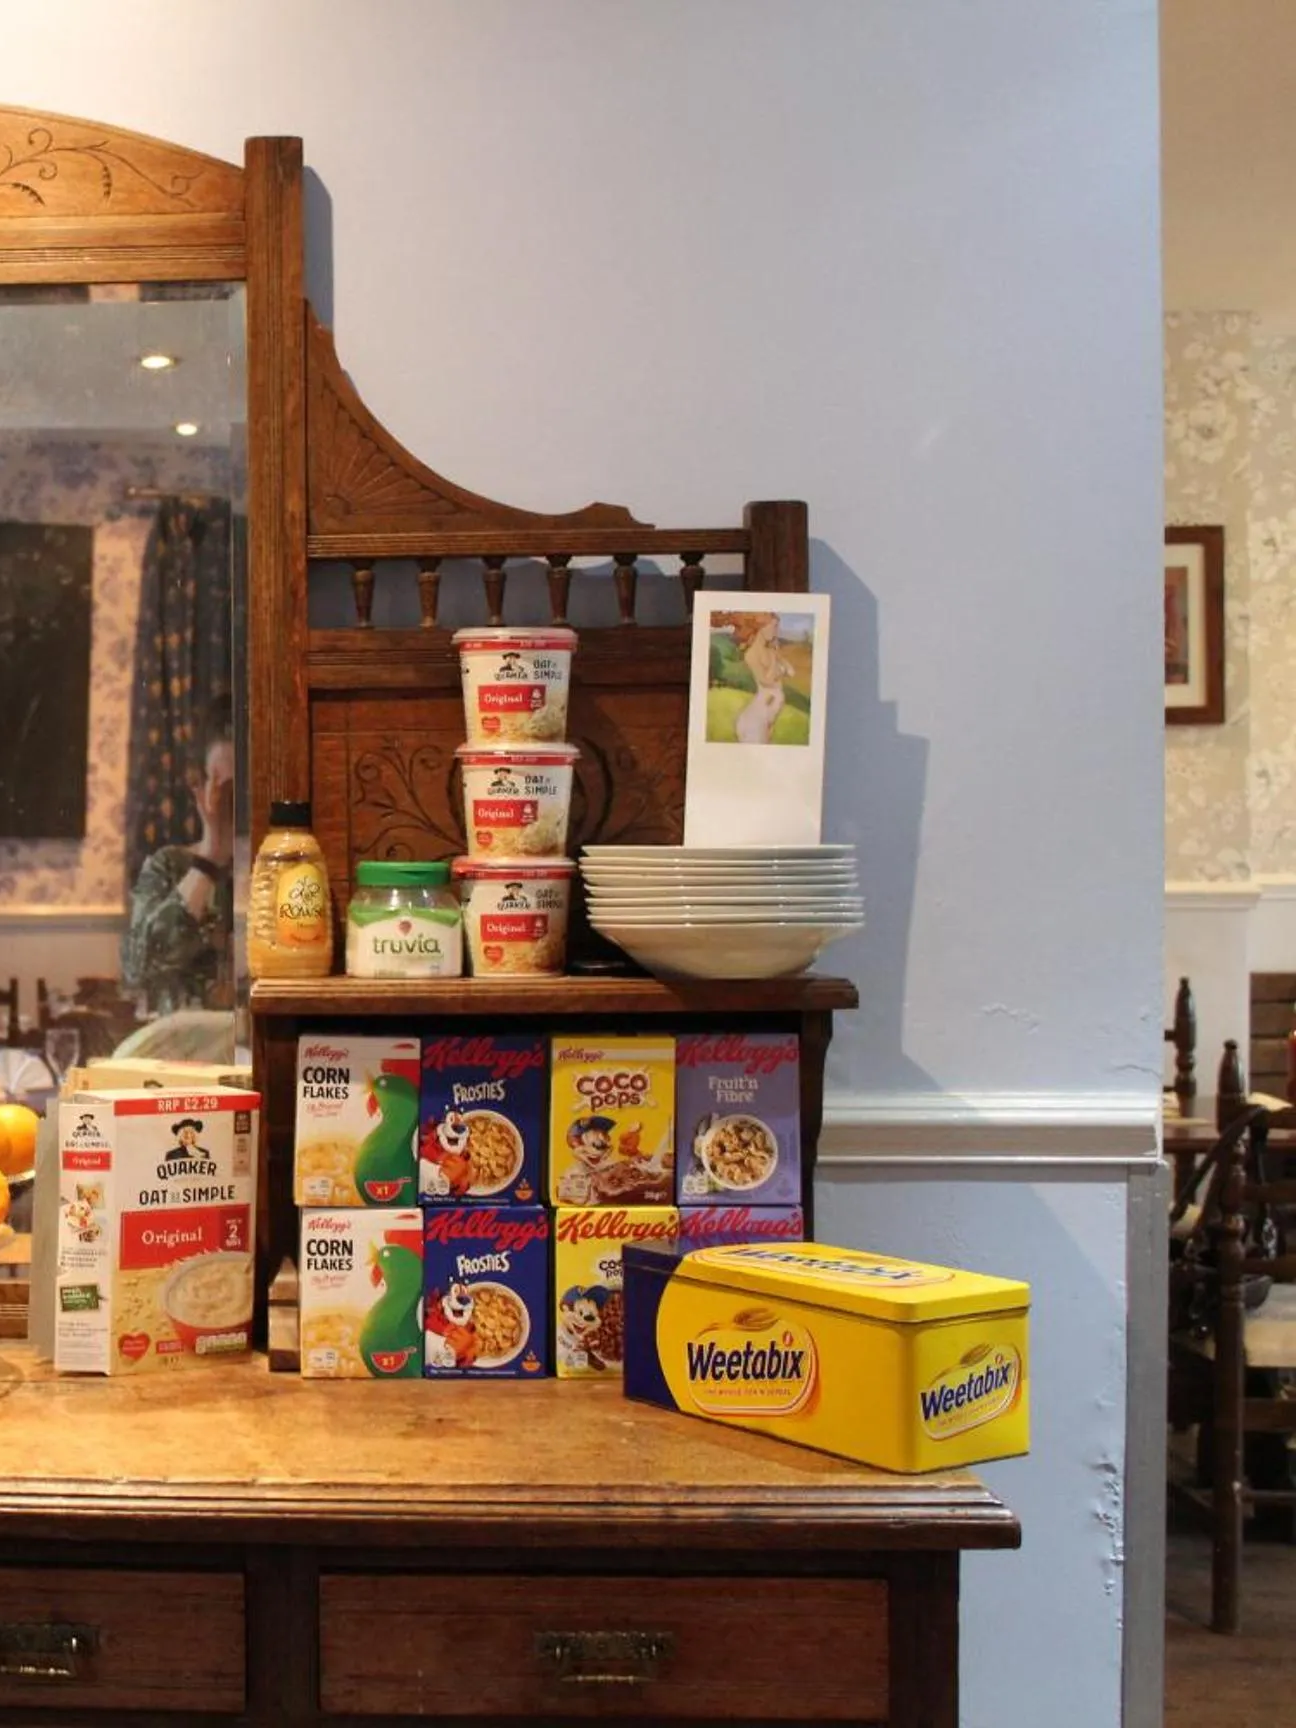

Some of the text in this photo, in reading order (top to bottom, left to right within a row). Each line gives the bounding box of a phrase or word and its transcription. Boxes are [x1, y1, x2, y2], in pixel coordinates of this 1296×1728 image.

[478, 807, 514, 821] Original
[422, 1036, 544, 1078] Kellogg's
[676, 1034, 798, 1075] Kellogg's
[303, 1066, 350, 1084] CORN
[303, 1086, 350, 1100] FLAKES
[715, 1089, 755, 1104] Fibre
[157, 1097, 218, 1112] RRP £2.29
[156, 1160, 217, 1180] QUAKER
[139, 1189, 168, 1205] OAT
[182, 1185, 235, 1203] SIMPLE
[229, 1224, 238, 1237] 2
[307, 1217, 352, 1233] Kellogg's
[426, 1209, 549, 1250] Kellogg's
[141, 1226, 203, 1248] Original
[306, 1239, 354, 1257] CORN
[307, 1257, 354, 1271] FLAKES
[687, 1330, 804, 1381] Weetabix
[920, 1354, 1011, 1421] Weetabix
